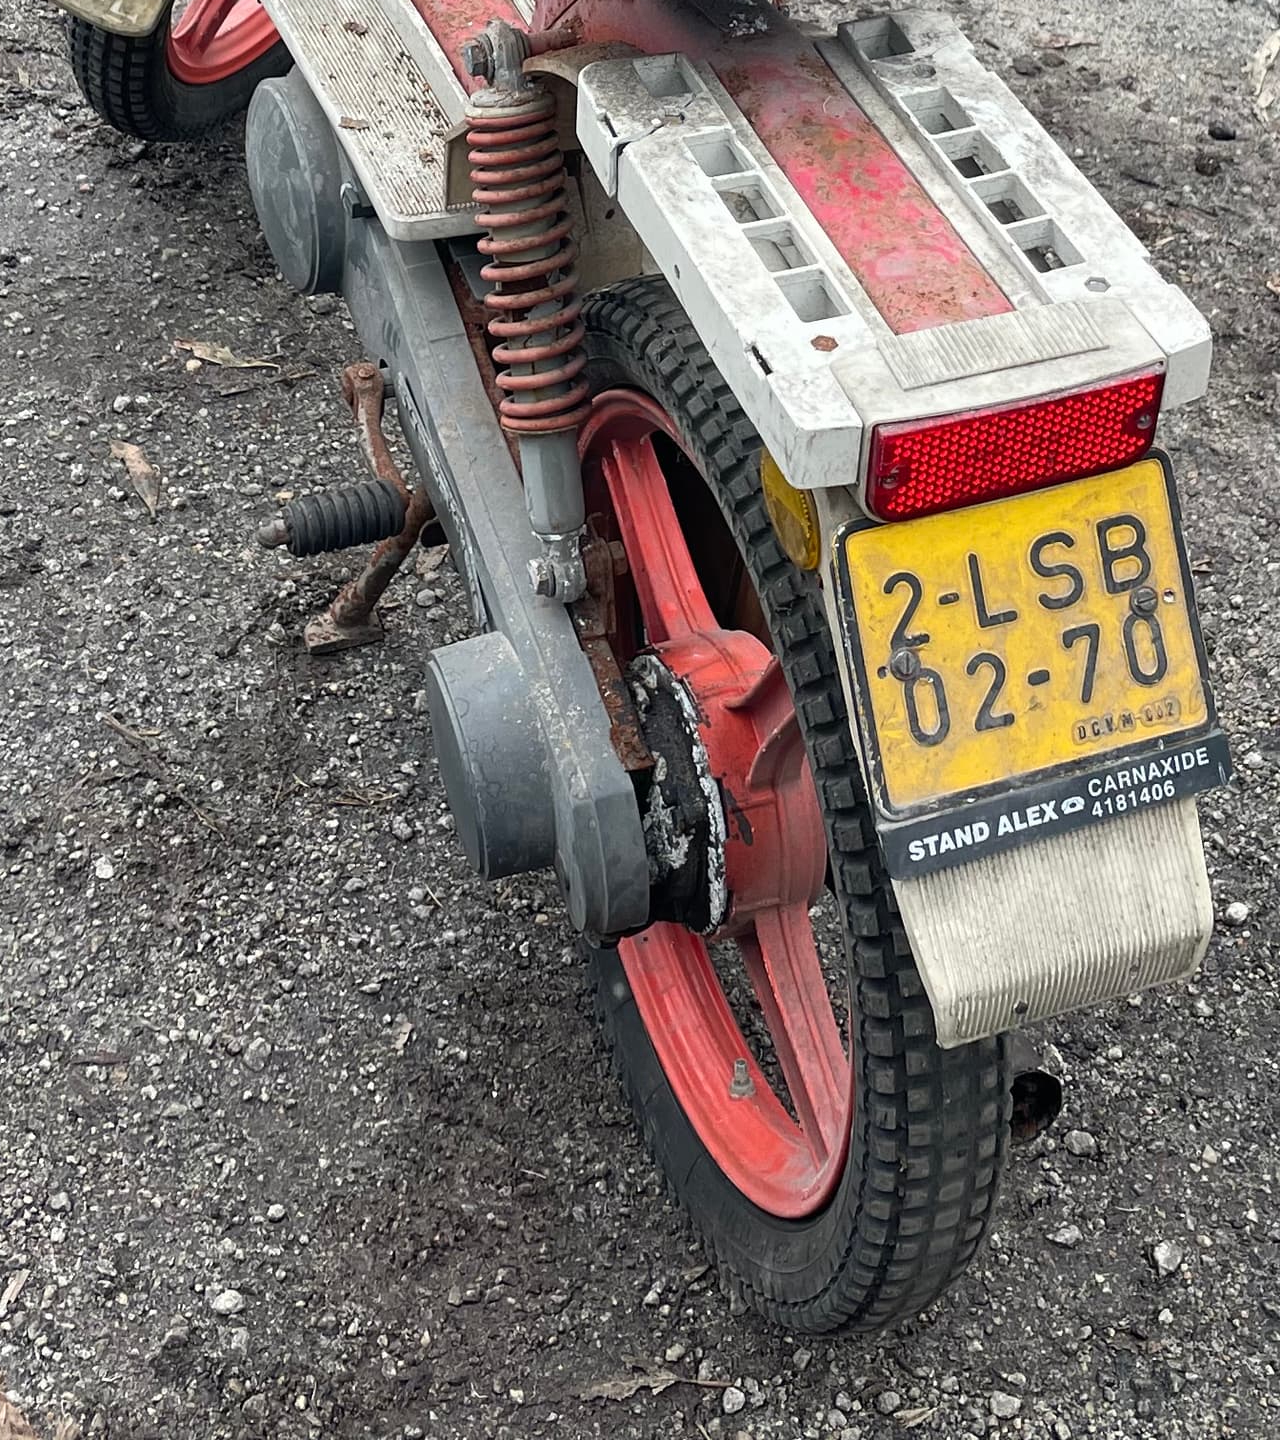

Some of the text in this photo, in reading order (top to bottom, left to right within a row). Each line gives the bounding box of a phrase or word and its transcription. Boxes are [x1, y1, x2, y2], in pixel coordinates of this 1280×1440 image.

[883, 514, 1151, 650] 2-LSB
[903, 614, 1169, 746] 02-70
[1087, 746, 1210, 798] CARNAXIDE
[1091, 779, 1176, 819] 4181406
[907, 800, 1059, 863] STAND ALEX
